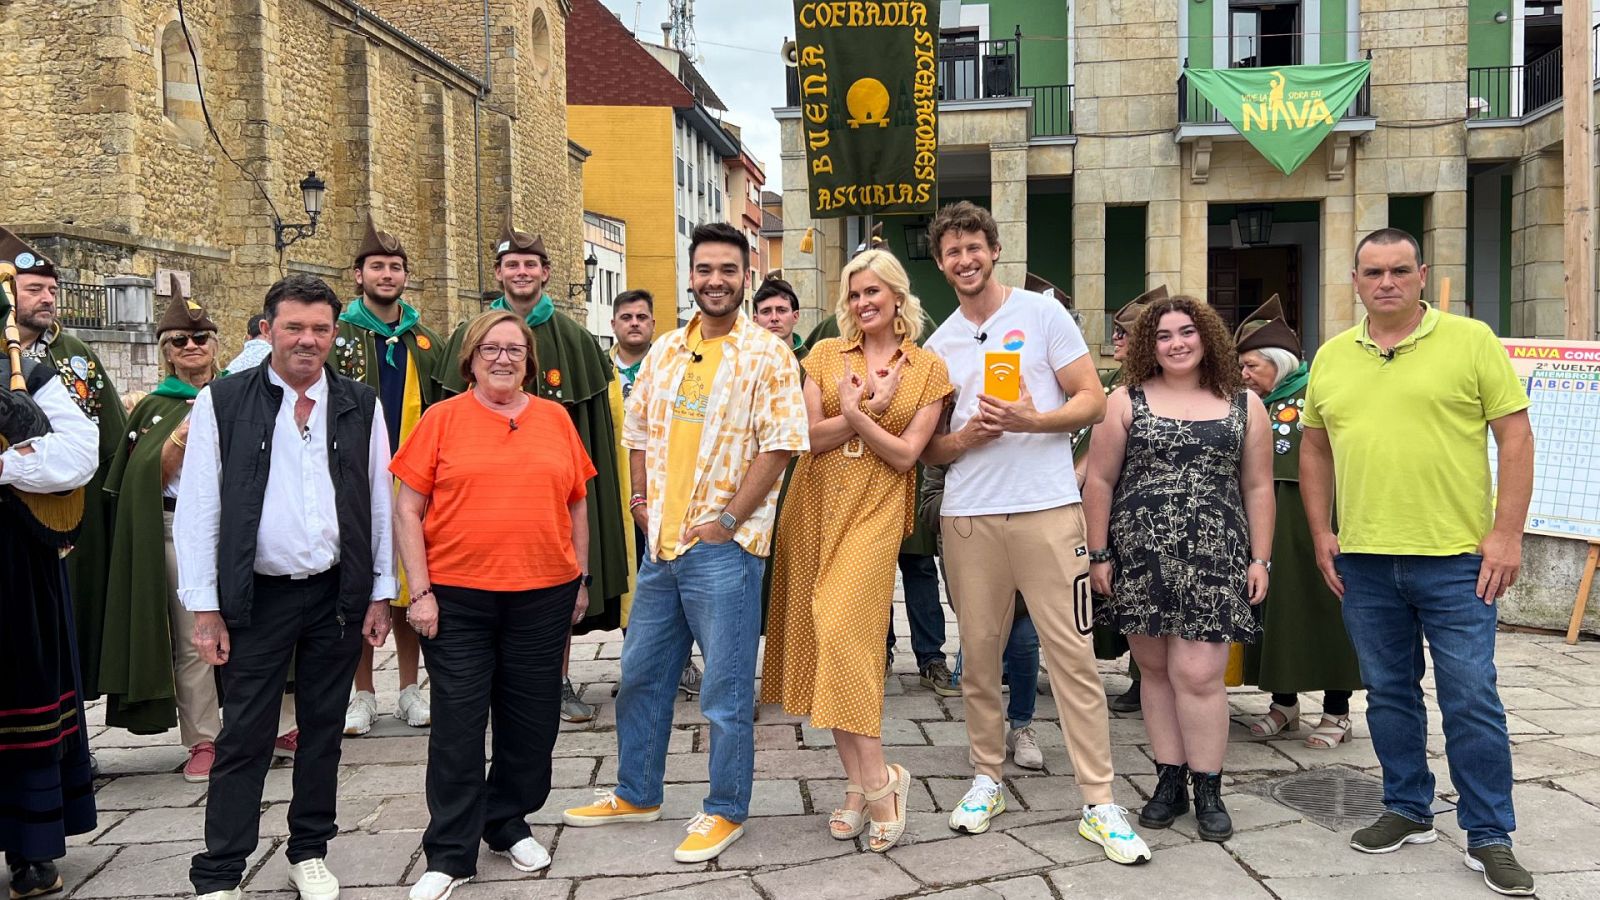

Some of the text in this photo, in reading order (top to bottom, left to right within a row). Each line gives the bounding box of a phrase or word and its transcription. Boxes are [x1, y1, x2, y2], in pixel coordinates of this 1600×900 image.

[800, 44, 833, 176] BUENA
[1243, 98, 1333, 131] NAVA
[816, 183, 931, 211] ASTURIAS
[1514, 347, 1559, 358] NAVA
[1535, 371, 1595, 379] MIEMBROS
[1534, 380, 1543, 388] A
[1548, 380, 1556, 388] B
[1562, 381, 1570, 389] C
[1576, 382, 1585, 390] D
[1590, 383, 1599, 391] E
